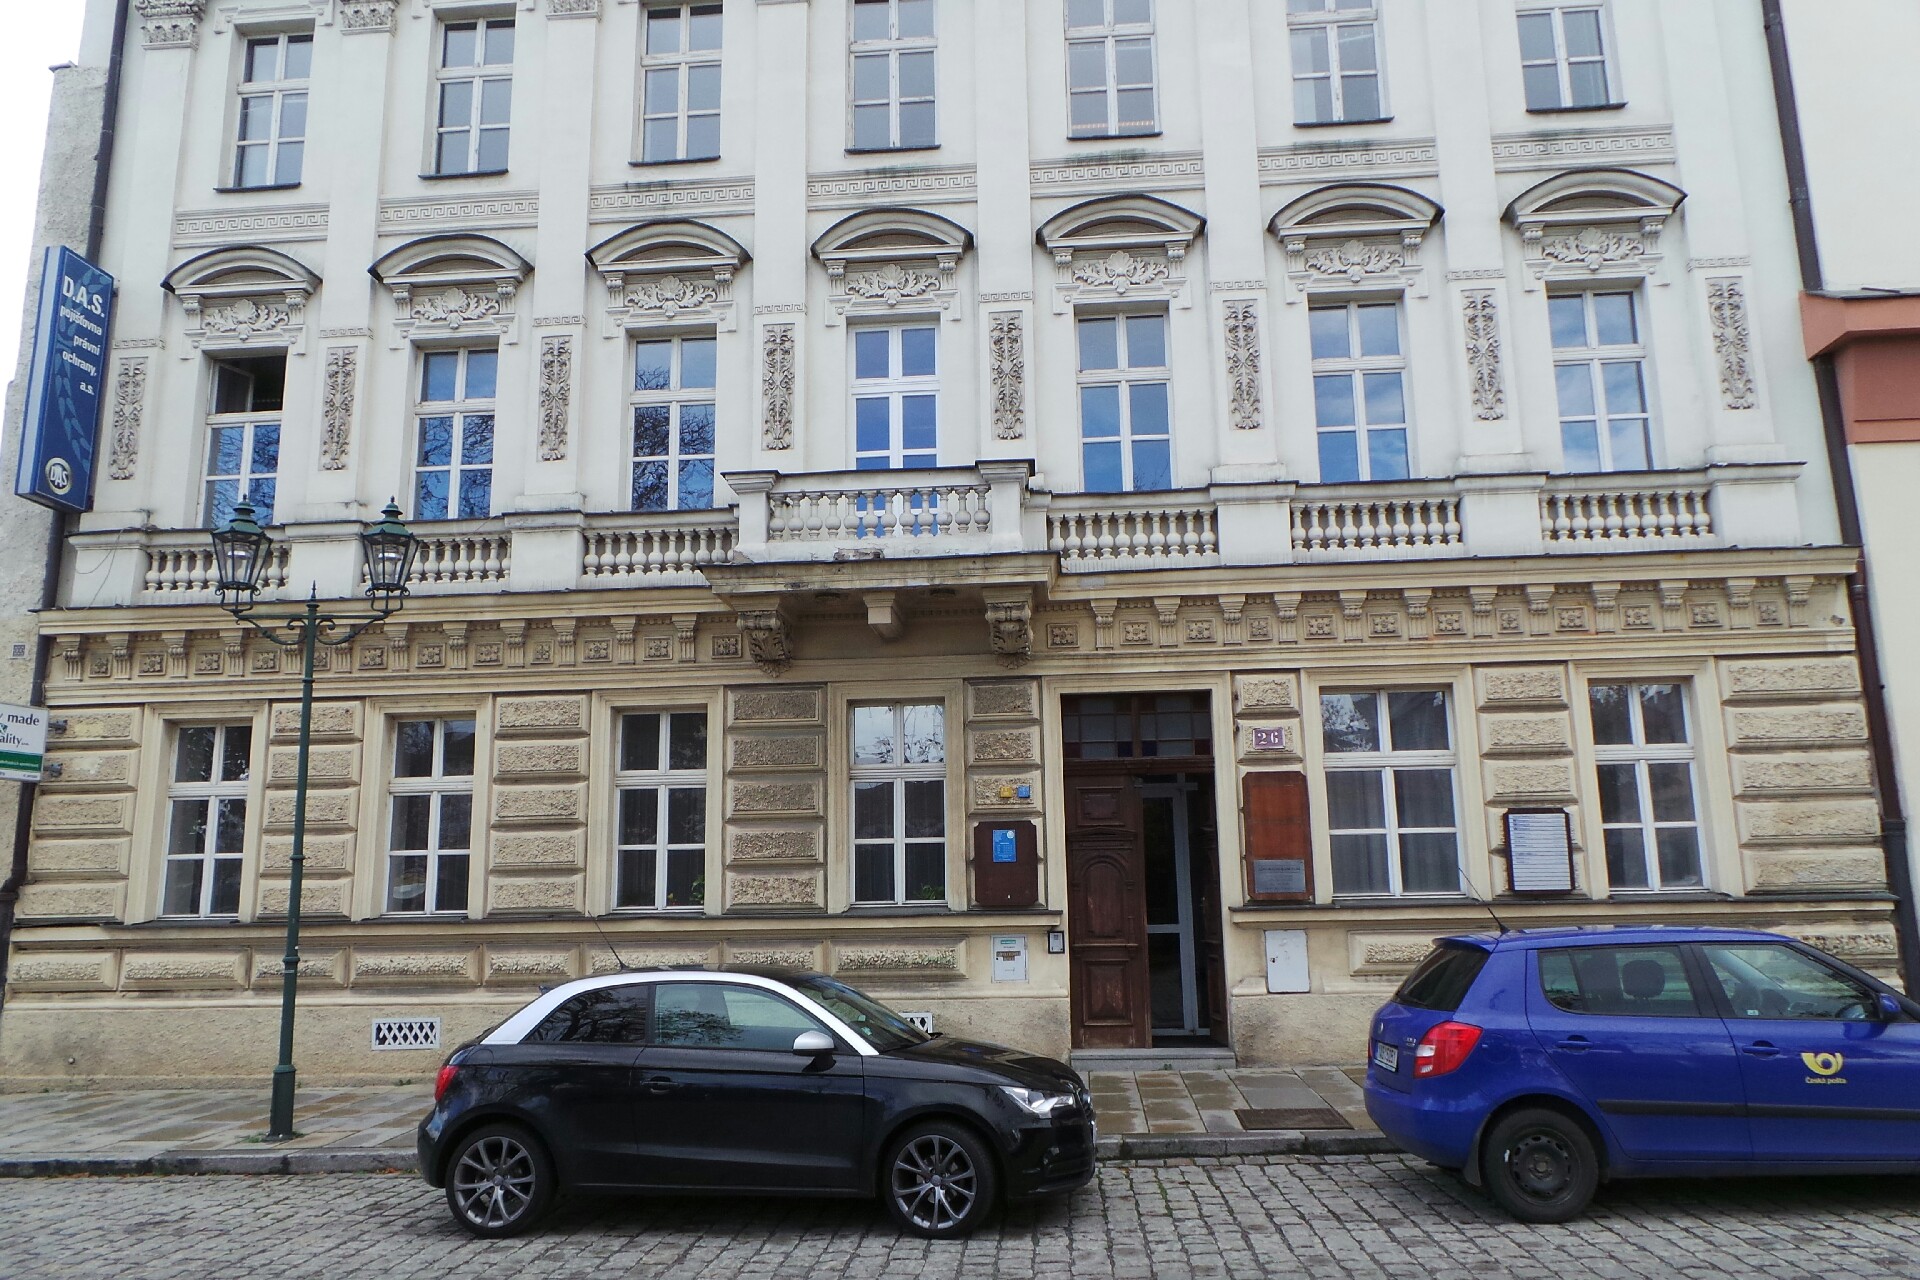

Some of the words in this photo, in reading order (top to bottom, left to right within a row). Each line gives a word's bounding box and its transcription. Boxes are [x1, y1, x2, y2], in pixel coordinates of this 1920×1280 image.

[62, 275, 105, 318] D.A.S.
[60, 305, 103, 336] pojišťovna
[73, 335, 101, 356] právní
[62, 350, 97, 377] ochrany,
[79, 381, 95, 396] a.s.
[50, 465, 68, 488] DAS
[7, 713, 40, 726] made
[1257, 731, 1279, 745] 26
